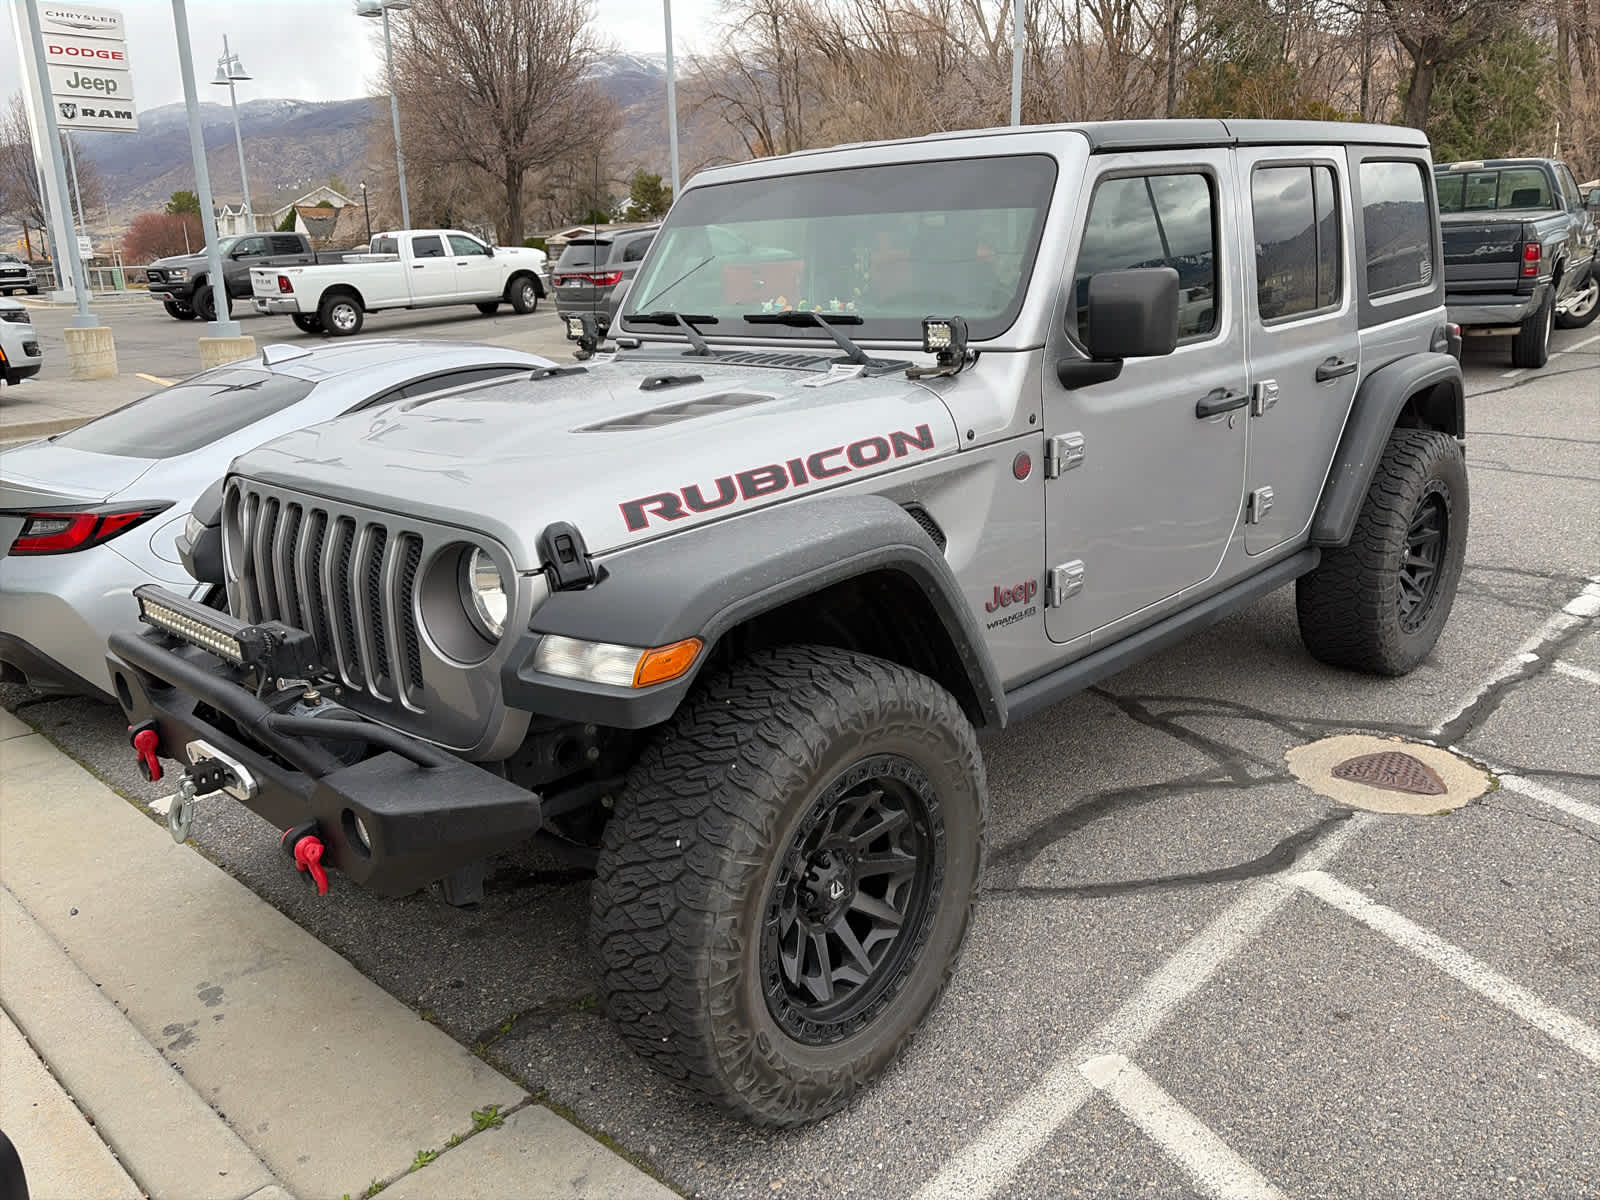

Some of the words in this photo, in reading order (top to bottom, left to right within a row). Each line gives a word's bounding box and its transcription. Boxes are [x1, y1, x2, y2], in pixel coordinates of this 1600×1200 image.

[45, 10, 118, 23] CHRYSLER
[49, 45, 124, 60] DODGE
[66, 71, 117, 94] Jeep
[81, 108, 132, 119] RAM
[618, 423, 935, 533] RUBICON
[985, 578, 1037, 613] Jeep
[986, 606, 1036, 629] WRANGLER
